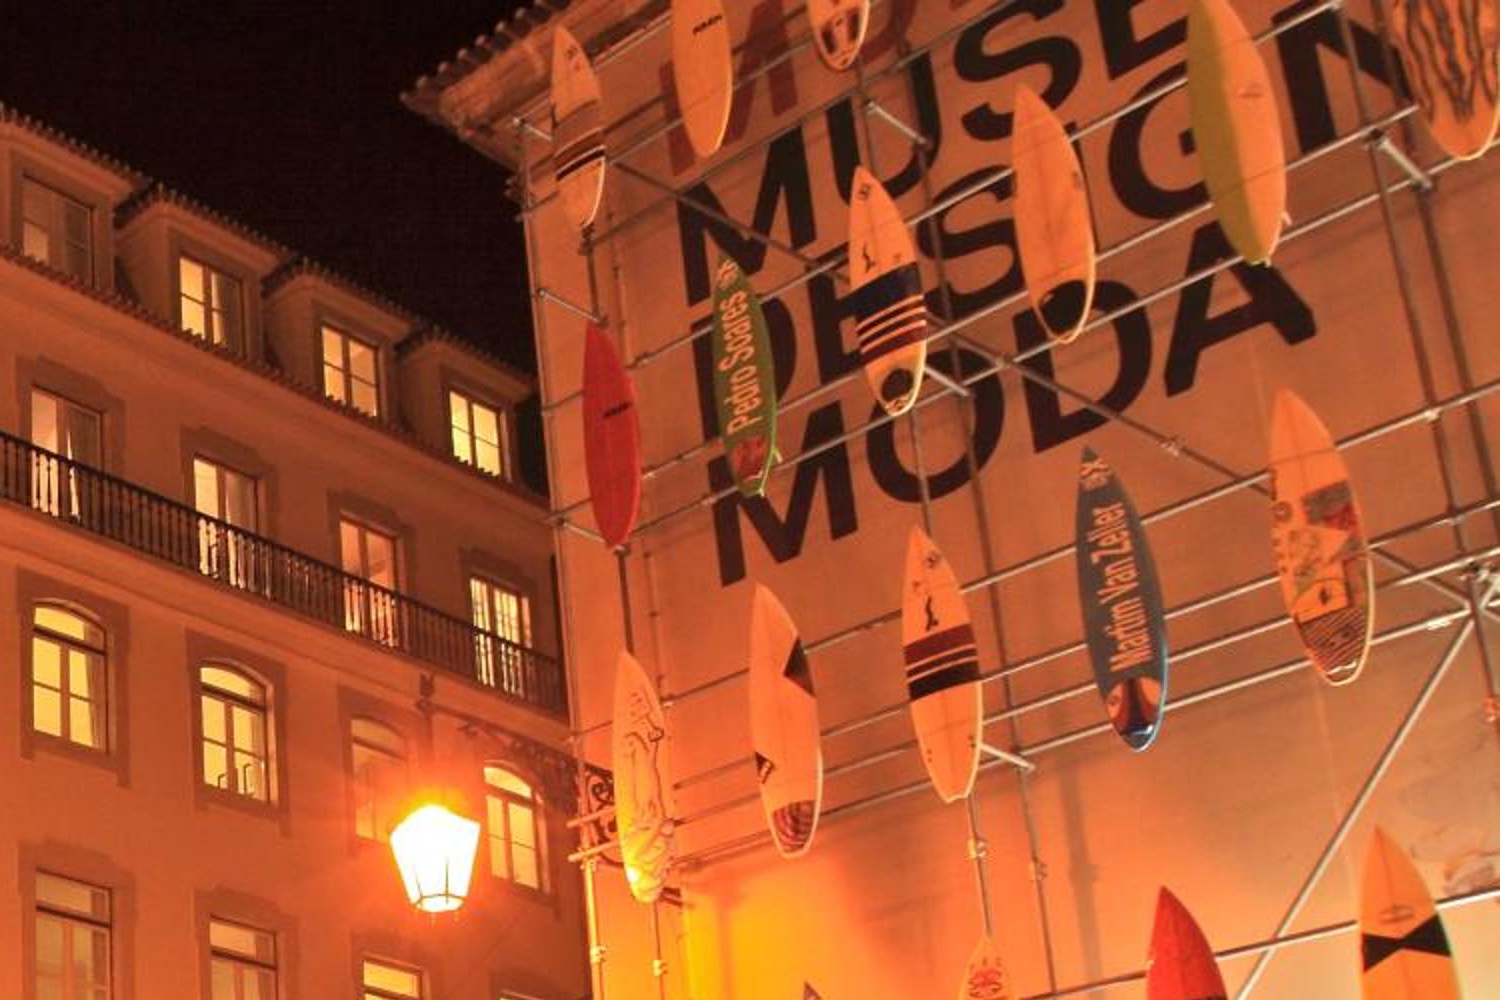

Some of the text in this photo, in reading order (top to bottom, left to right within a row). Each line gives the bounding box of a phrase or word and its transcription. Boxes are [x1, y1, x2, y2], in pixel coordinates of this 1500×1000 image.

[689, 0, 1418, 446] DESGN
[718, 291, 755, 371] Soares
[705, 219, 1316, 587] MODA
[1097, 556, 1142, 605] Van
[1105, 597, 1152, 673] Martim
